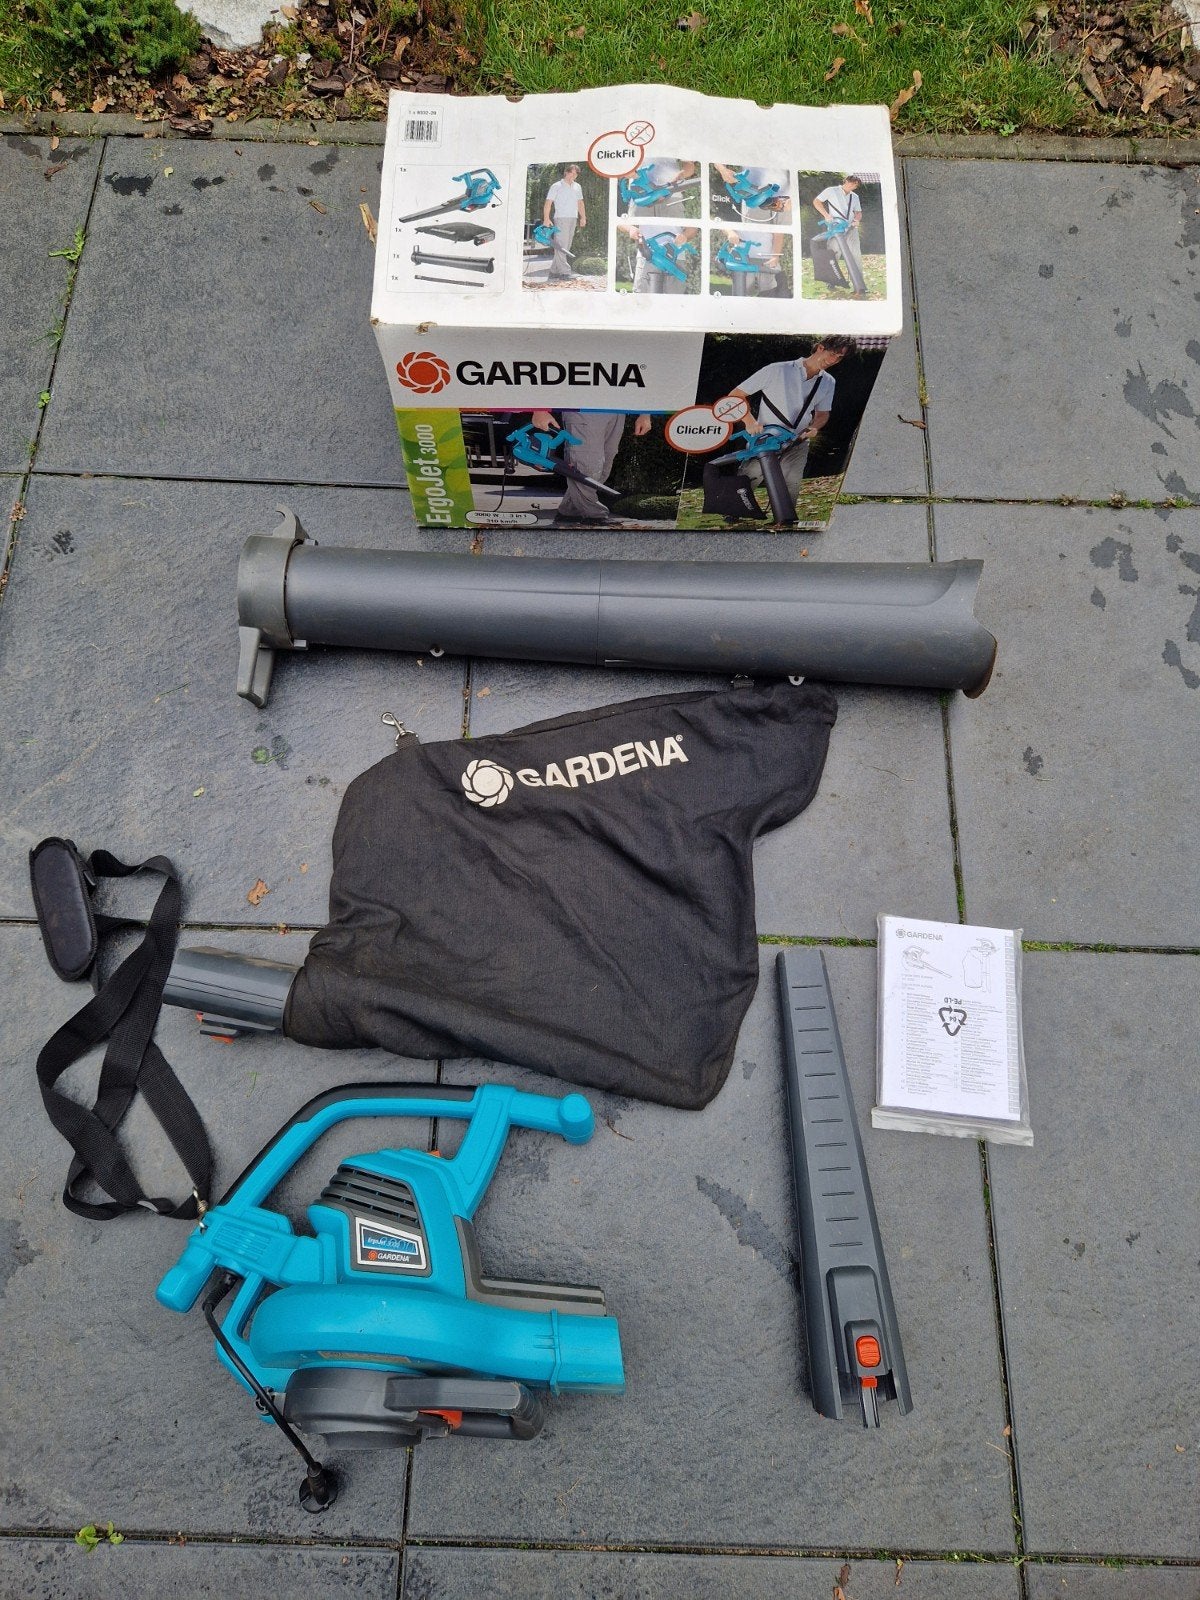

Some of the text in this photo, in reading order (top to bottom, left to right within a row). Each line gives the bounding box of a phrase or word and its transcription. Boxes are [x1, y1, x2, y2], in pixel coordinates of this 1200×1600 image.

[597, 149, 635, 160] ClickFit
[712, 194, 731, 203] Click
[455, 360, 646, 388] GARDENA
[676, 424, 722, 436] ClickFit
[413, 424, 454, 524] ErgoJet 3000
[516, 736, 689, 788] GARDENA
[906, 931, 944, 942] GARDENA
[377, 1252, 410, 1262] GARDENA
